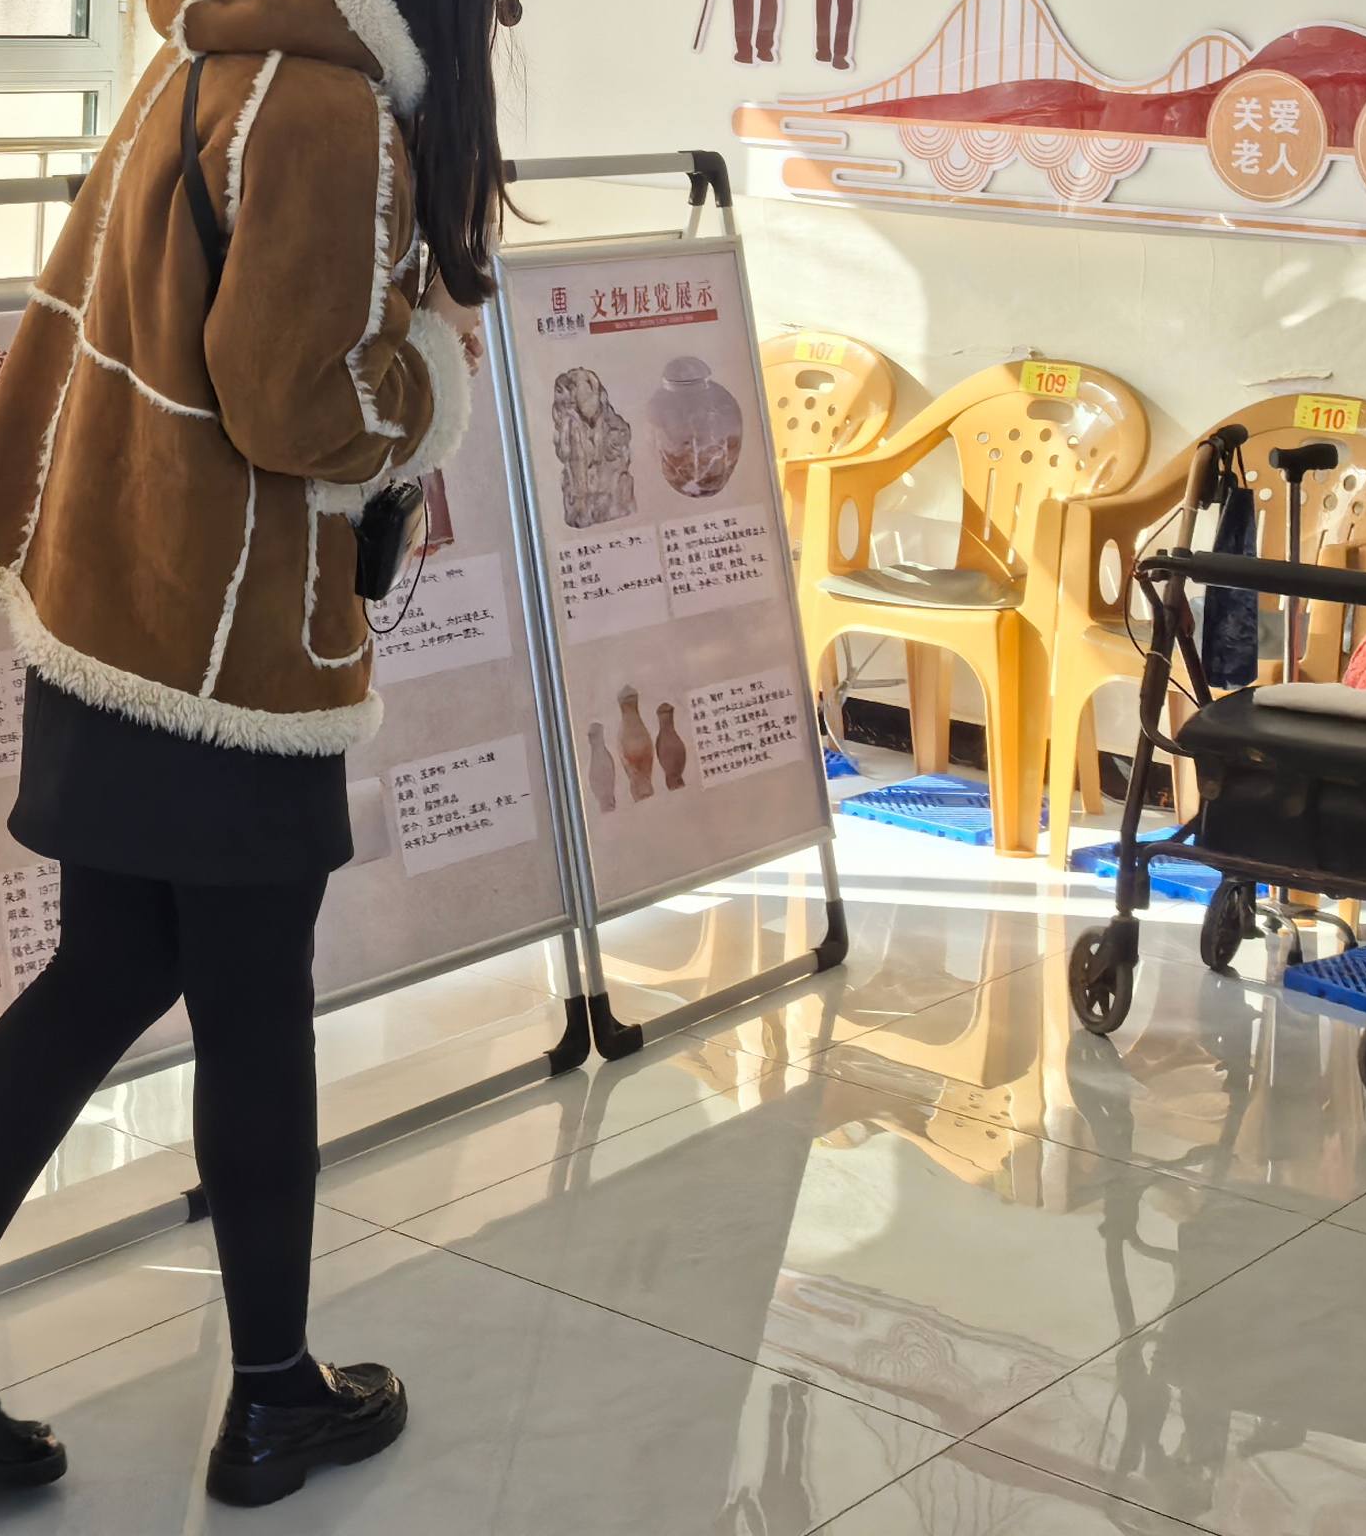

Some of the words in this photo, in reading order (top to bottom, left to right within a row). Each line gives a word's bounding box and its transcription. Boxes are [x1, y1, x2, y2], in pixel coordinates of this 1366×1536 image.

[1232, 96, 1301, 134] 关爱
[1231, 140, 1299, 178] 老人
[590, 280, 713, 319] 文物展览展示
[1036, 372, 1066, 393] 109
[1312, 407, 1345, 430] 110
